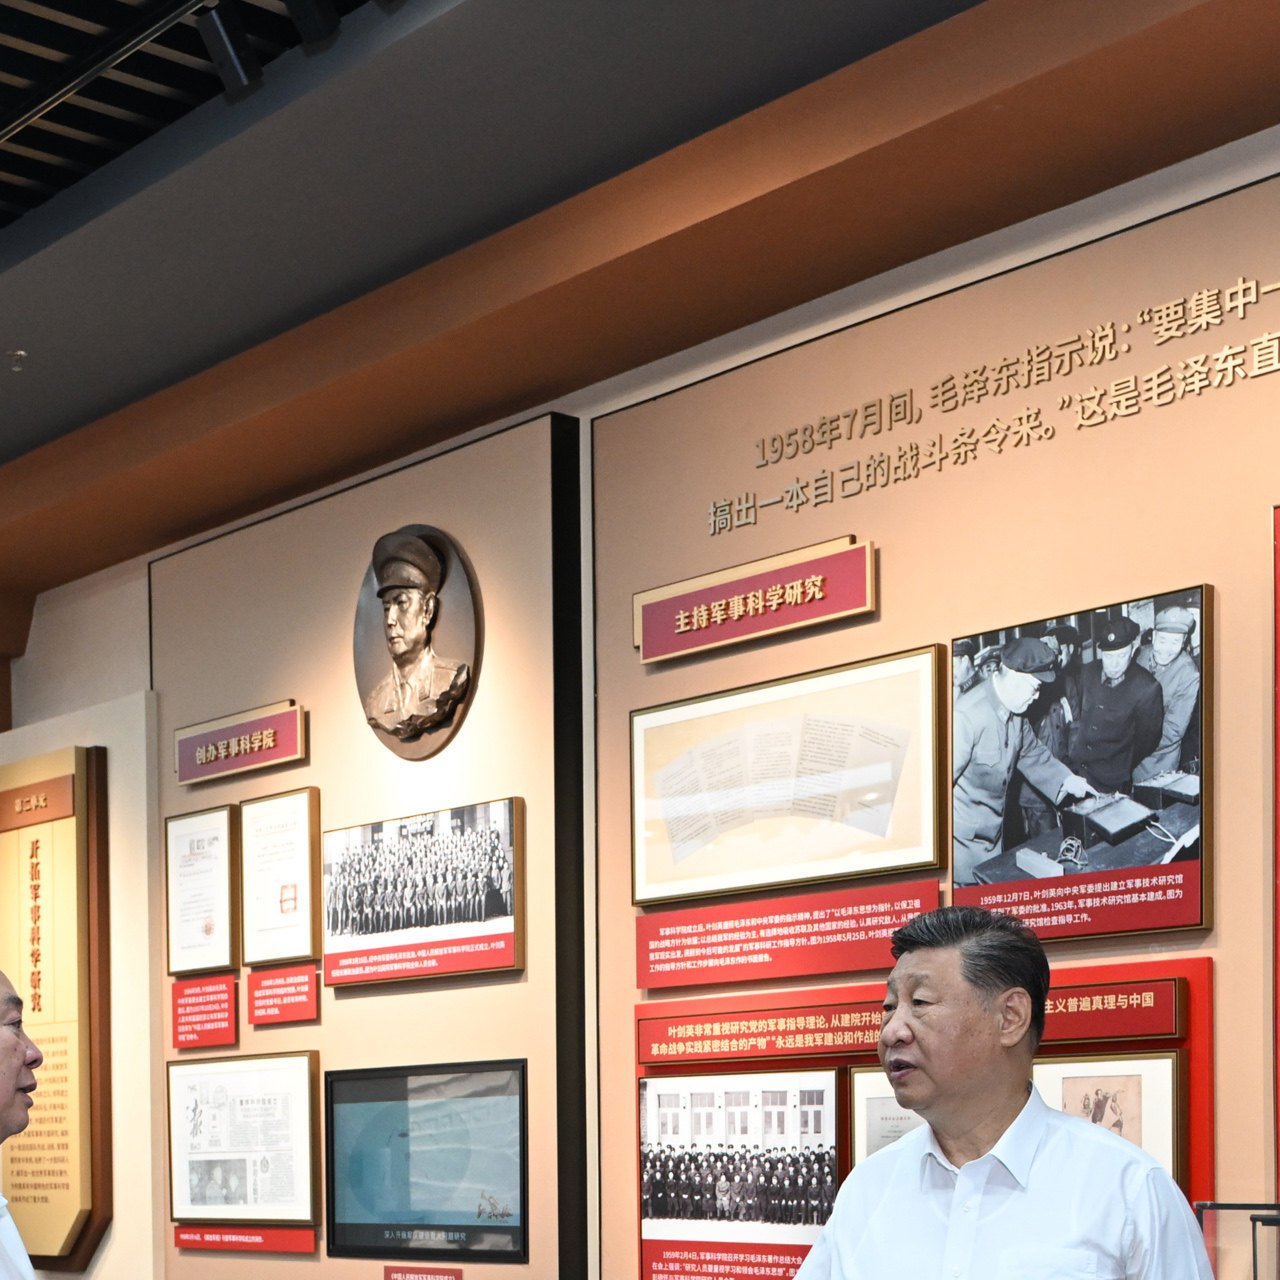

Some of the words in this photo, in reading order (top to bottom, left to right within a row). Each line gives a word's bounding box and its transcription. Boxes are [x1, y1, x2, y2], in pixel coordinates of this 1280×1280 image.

[674, 574, 826, 634] 主持军事科学研究
[195, 728, 276, 765] 创办军事科学院
[668, 1012, 889, 1038] 叶剑英非常重视研究党的军事指导理论，从建院开始
[1044, 991, 1155, 1014] 主义普遍真理与中国
